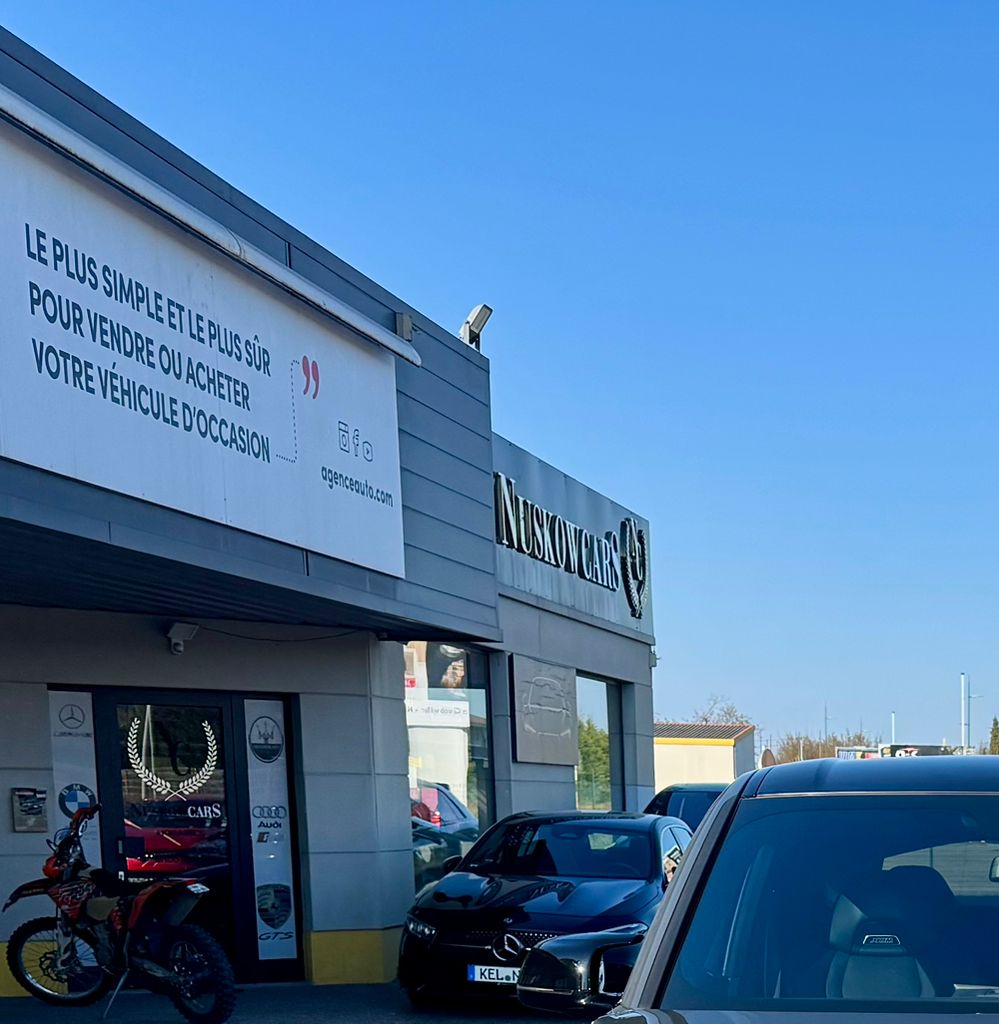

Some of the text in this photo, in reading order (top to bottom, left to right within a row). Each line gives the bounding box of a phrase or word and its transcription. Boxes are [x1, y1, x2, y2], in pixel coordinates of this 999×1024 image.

[25, 222, 271, 377] LE PLUS SIMPLE ET LE PLUS SÛR
[29, 280, 250, 411] POUR VENDRE OU ACHETER
[31, 337, 270, 463] VOTRE VÉHICULE D'OCCASION
[321, 466, 393, 507] agenceauto.com
[187, 803, 221, 818] CARS
[258, 931, 294, 941] GTS
[480, 967, 503, 981] KEL
